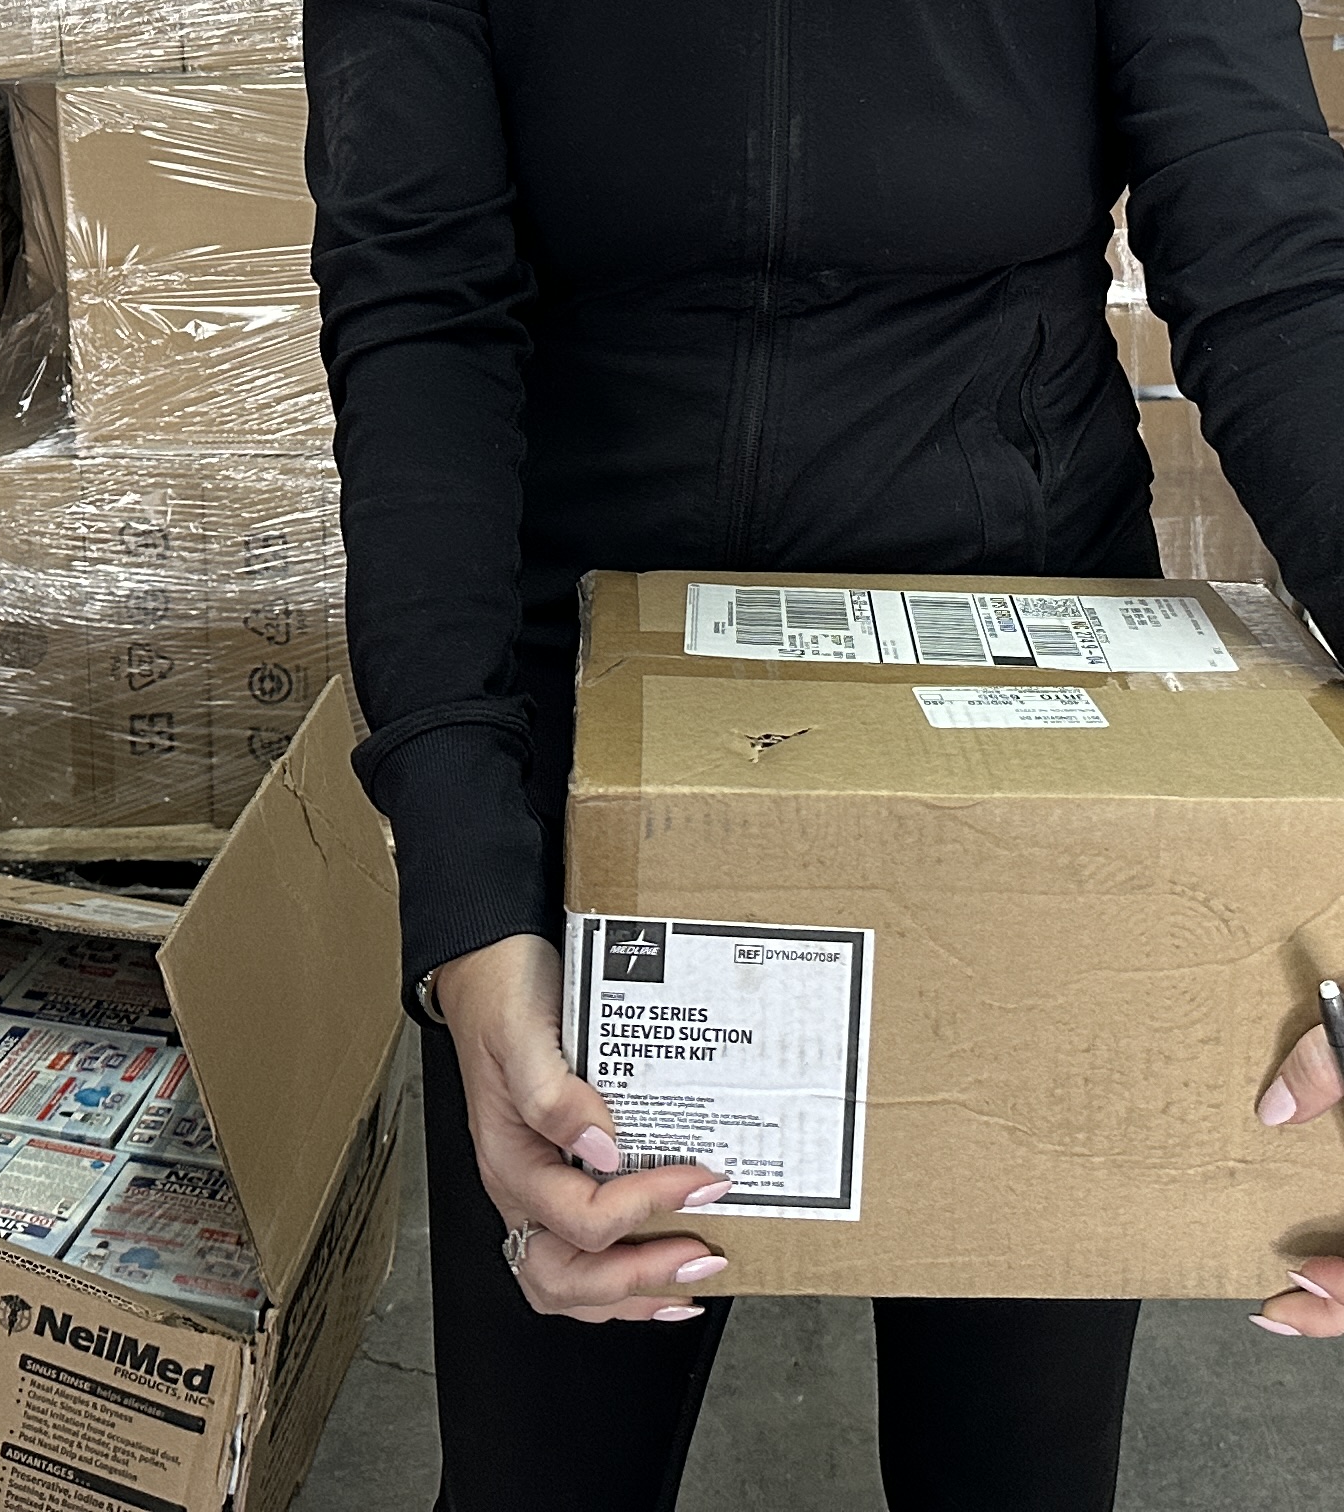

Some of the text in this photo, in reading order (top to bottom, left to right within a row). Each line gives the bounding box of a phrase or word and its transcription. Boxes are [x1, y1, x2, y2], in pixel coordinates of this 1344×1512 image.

[609, 945, 660, 957] MEDLINE
[737, 949, 761, 960] REF
[601, 1003, 708, 1022] D407 SERIES
[599, 1023, 753, 1044] SLEEVED SUCTION
[599, 1042, 717, 1061] CATHETER KIT
[598, 1062, 634, 1078] 8 FR
[597, 1080, 615, 1088] QTY:
[152, 1179, 212, 1198] SINUS
[33, 1304, 215, 1396] NeilMed
[26, 1359, 166, 1418] SINUS RINSE helps alleviate:
[113, 1366, 182, 1401] PRODUCTS,
[27, 1390, 116, 1429] Chronic Sinus Disease
[29, 1378, 54, 1394] Nasal
[55, 1387, 90, 1409] Allergies
[100, 1404, 134, 1424] Dryness
[25, 1401, 49, 1417] Nasal
[107, 1429, 159, 1458] occupational
[52, 1420, 79, 1438] animal
[18, 1432, 138, 1483] Post Nasal Drip and Congestion
[52, 1432, 75, 1450] smog
[111, 1453, 130, 1467] dust
[11, 1466, 72, 1499] Preservative,
[74, 1490, 105, 1509] Iodine
[6, 1490, 44, 1510] Premixed
